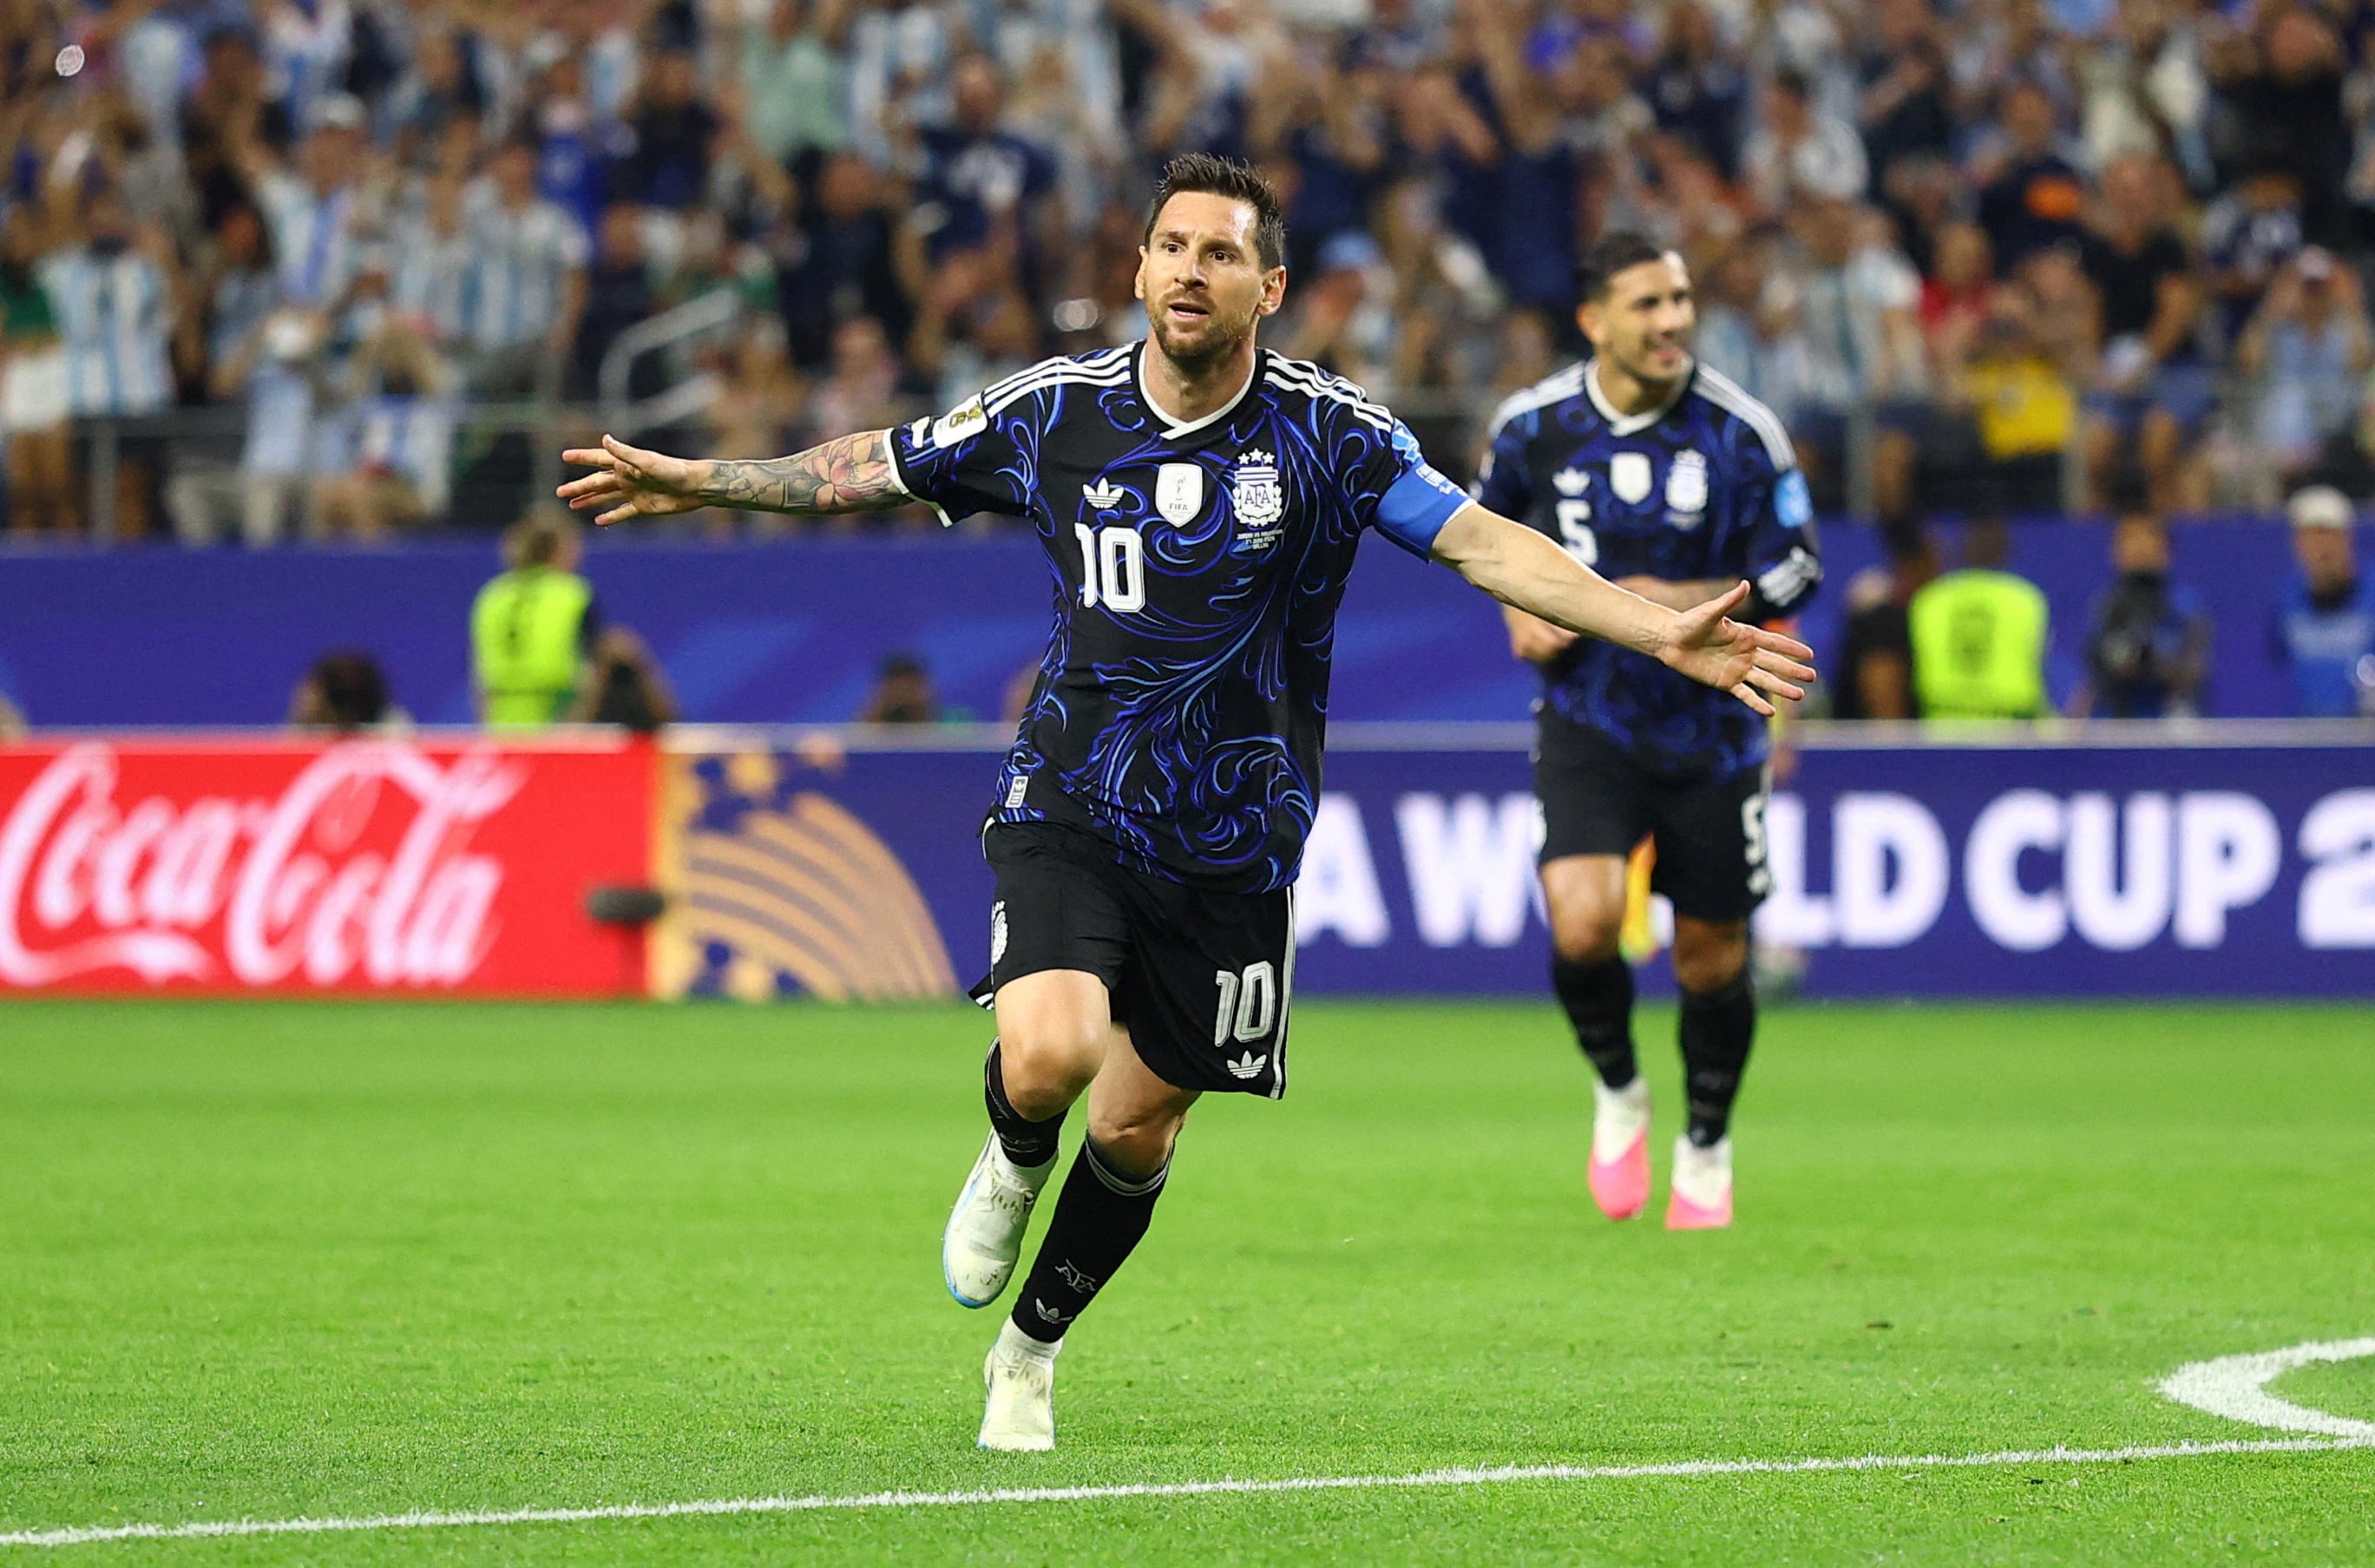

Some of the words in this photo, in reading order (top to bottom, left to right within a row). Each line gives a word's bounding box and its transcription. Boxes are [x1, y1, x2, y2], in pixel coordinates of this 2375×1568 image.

[1169, 502, 1188, 511] FIFA
[1244, 482, 1271, 508] AFA
[1556, 500, 1598, 566] 5
[1074, 522, 1145, 613] 10
[1395, 791, 1950, 949] WLD
[1965, 786, 2281, 952] CUP
[1214, 960, 1276, 1047] 10
